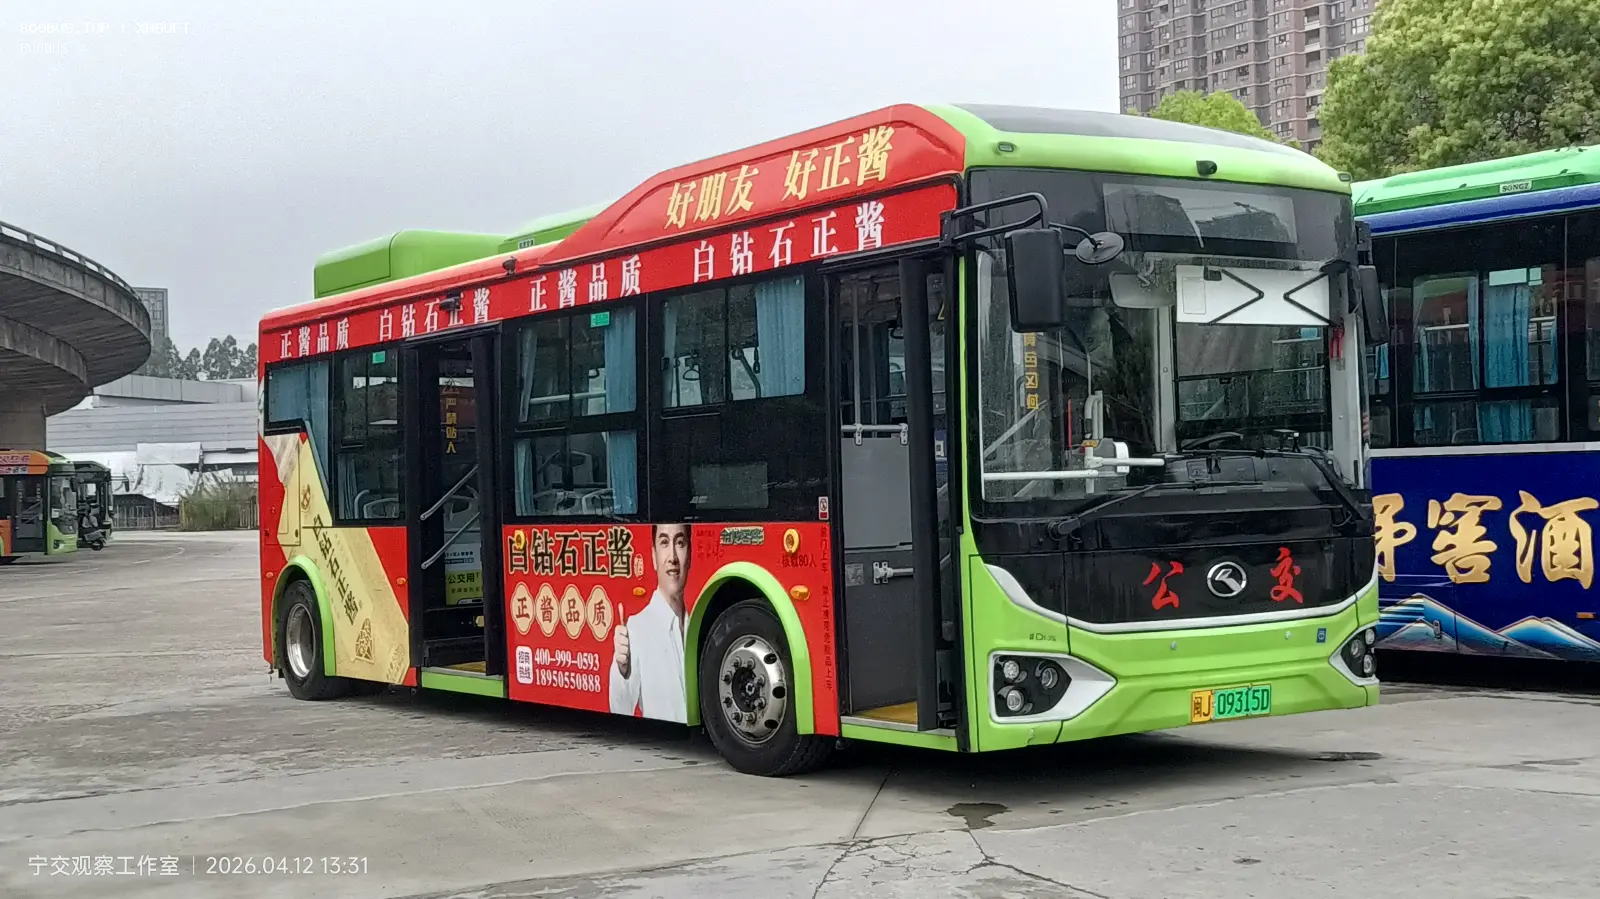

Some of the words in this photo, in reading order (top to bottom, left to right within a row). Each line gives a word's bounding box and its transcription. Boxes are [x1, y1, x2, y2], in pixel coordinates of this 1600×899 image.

[663, 164, 760, 230] 好朋友
[781, 125, 895, 202] 好正酱
[1502, 182, 1529, 192] SONGZ
[279, 316, 350, 360] 正酱品质
[528, 254, 643, 313] 正酱品质
[693, 201, 885, 284] 白钻石正酱
[508, 526, 634, 579] 白钻石正酱
[1142, 561, 1184, 611] 公
[1270, 547, 1303, 604] 交
[515, 595, 607, 628] 正酱品质
[534, 648, 600, 671] 400-999-0593
[535, 668, 601, 693] 18950550888
[1217, 688, 1270, 716] 09315D
